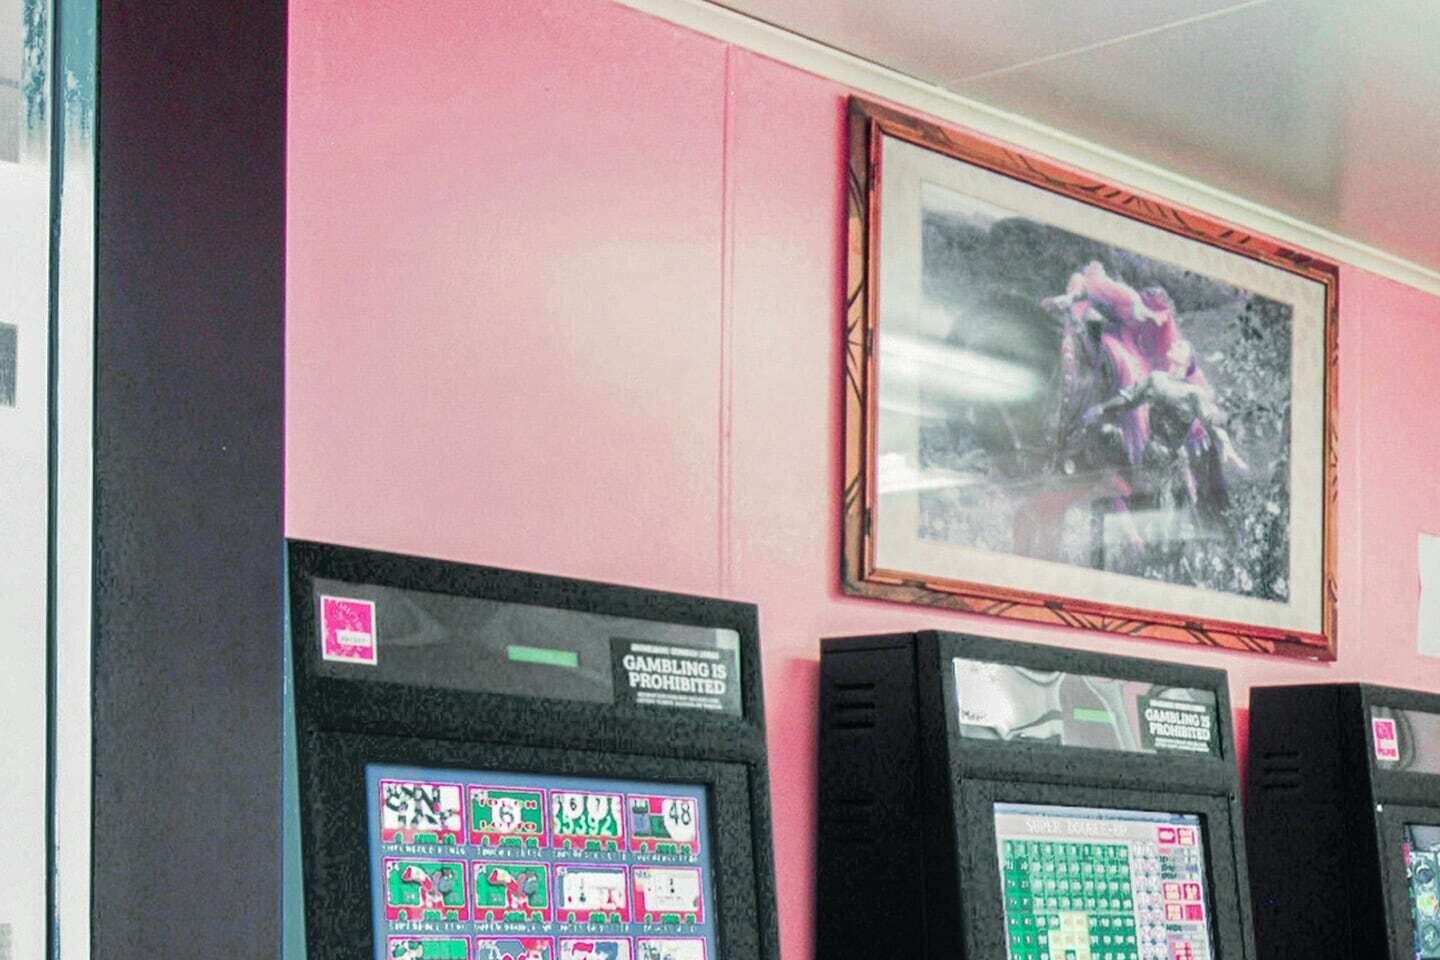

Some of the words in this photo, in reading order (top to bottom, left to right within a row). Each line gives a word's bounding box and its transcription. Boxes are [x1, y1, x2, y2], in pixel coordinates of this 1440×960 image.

[622, 654, 709, 677] GAMBLING
[711, 663, 727, 679] IS
[628, 671, 726, 695] PROHIBITED
[1145, 708, 1200, 727] GAMBLING
[1149, 722, 1211, 741] PROHIBITED
